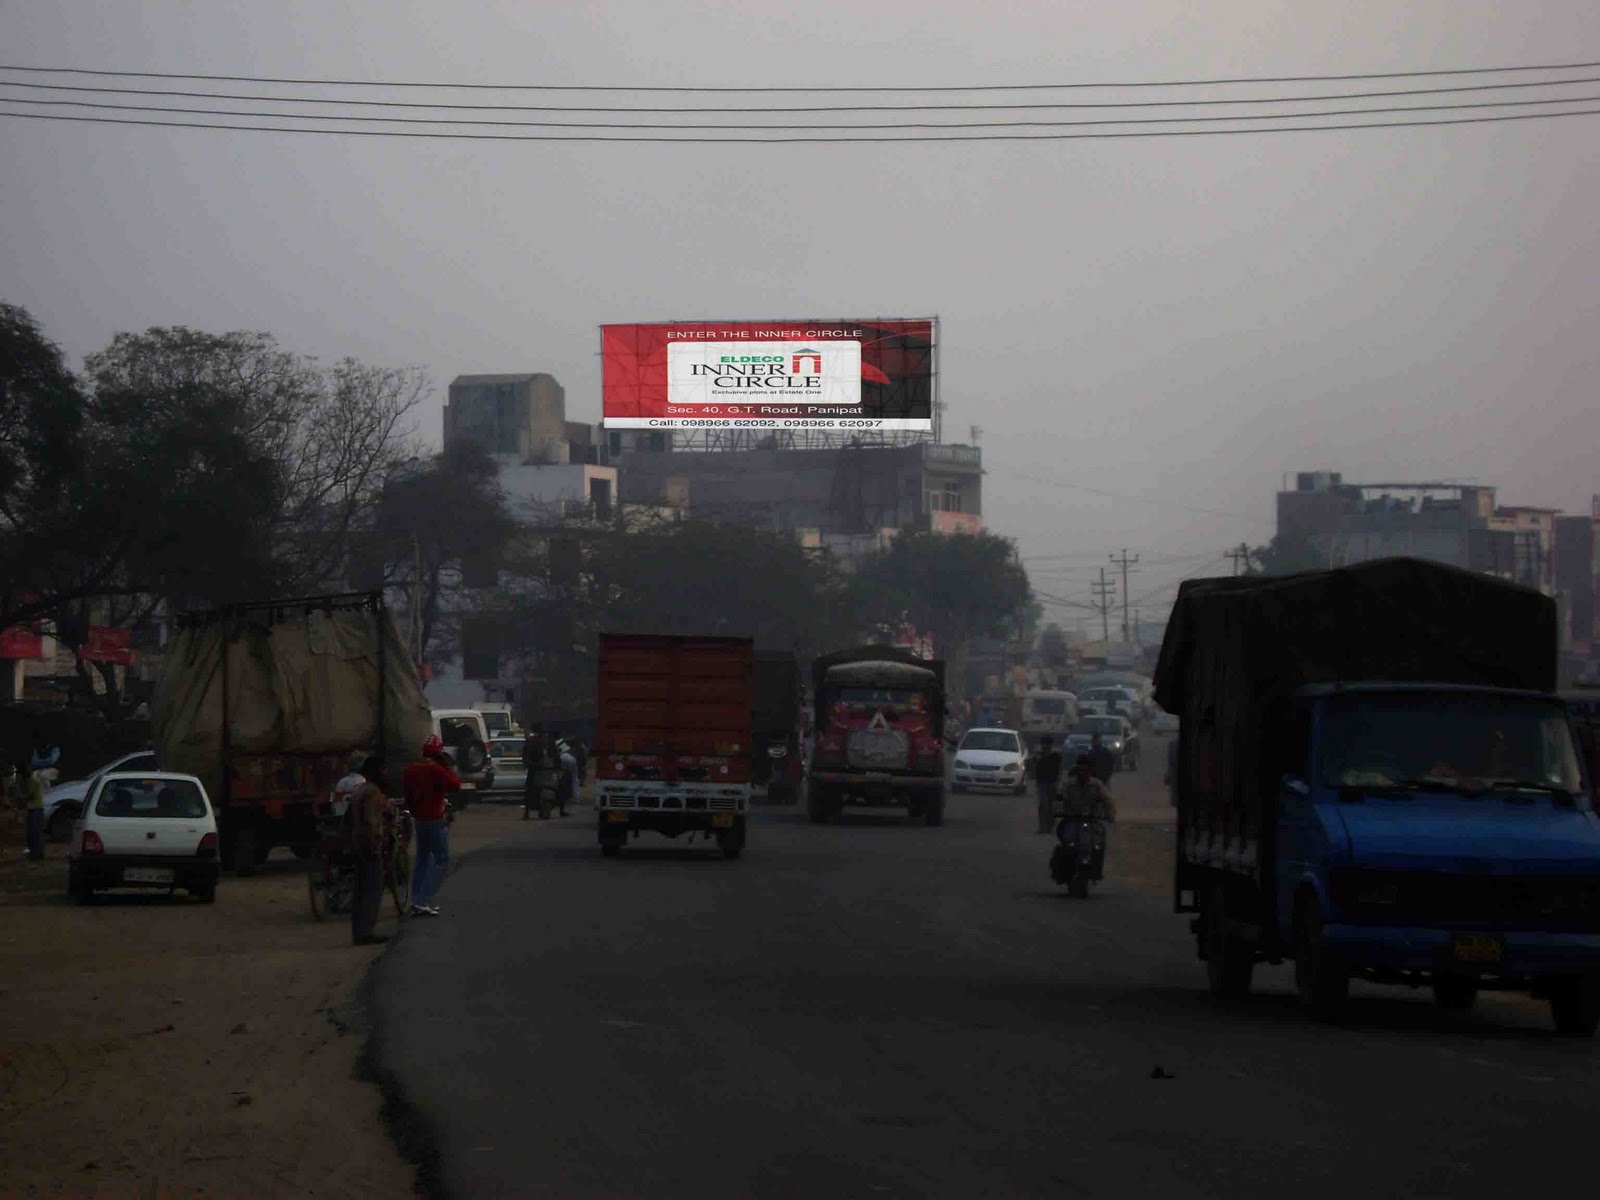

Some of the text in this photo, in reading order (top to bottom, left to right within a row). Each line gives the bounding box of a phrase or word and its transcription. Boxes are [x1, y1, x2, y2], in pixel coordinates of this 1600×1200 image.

[667, 331, 716, 339] ENTER
[754, 330, 801, 338] INNER
[690, 364, 786, 375] INNER
[713, 376, 821, 388] CIRCLE
[667, 406, 697, 414] Sec.
[727, 406, 756, 414] G.T.
[807, 406, 863, 415] Panipat
[649, 419, 678, 427] Call:
